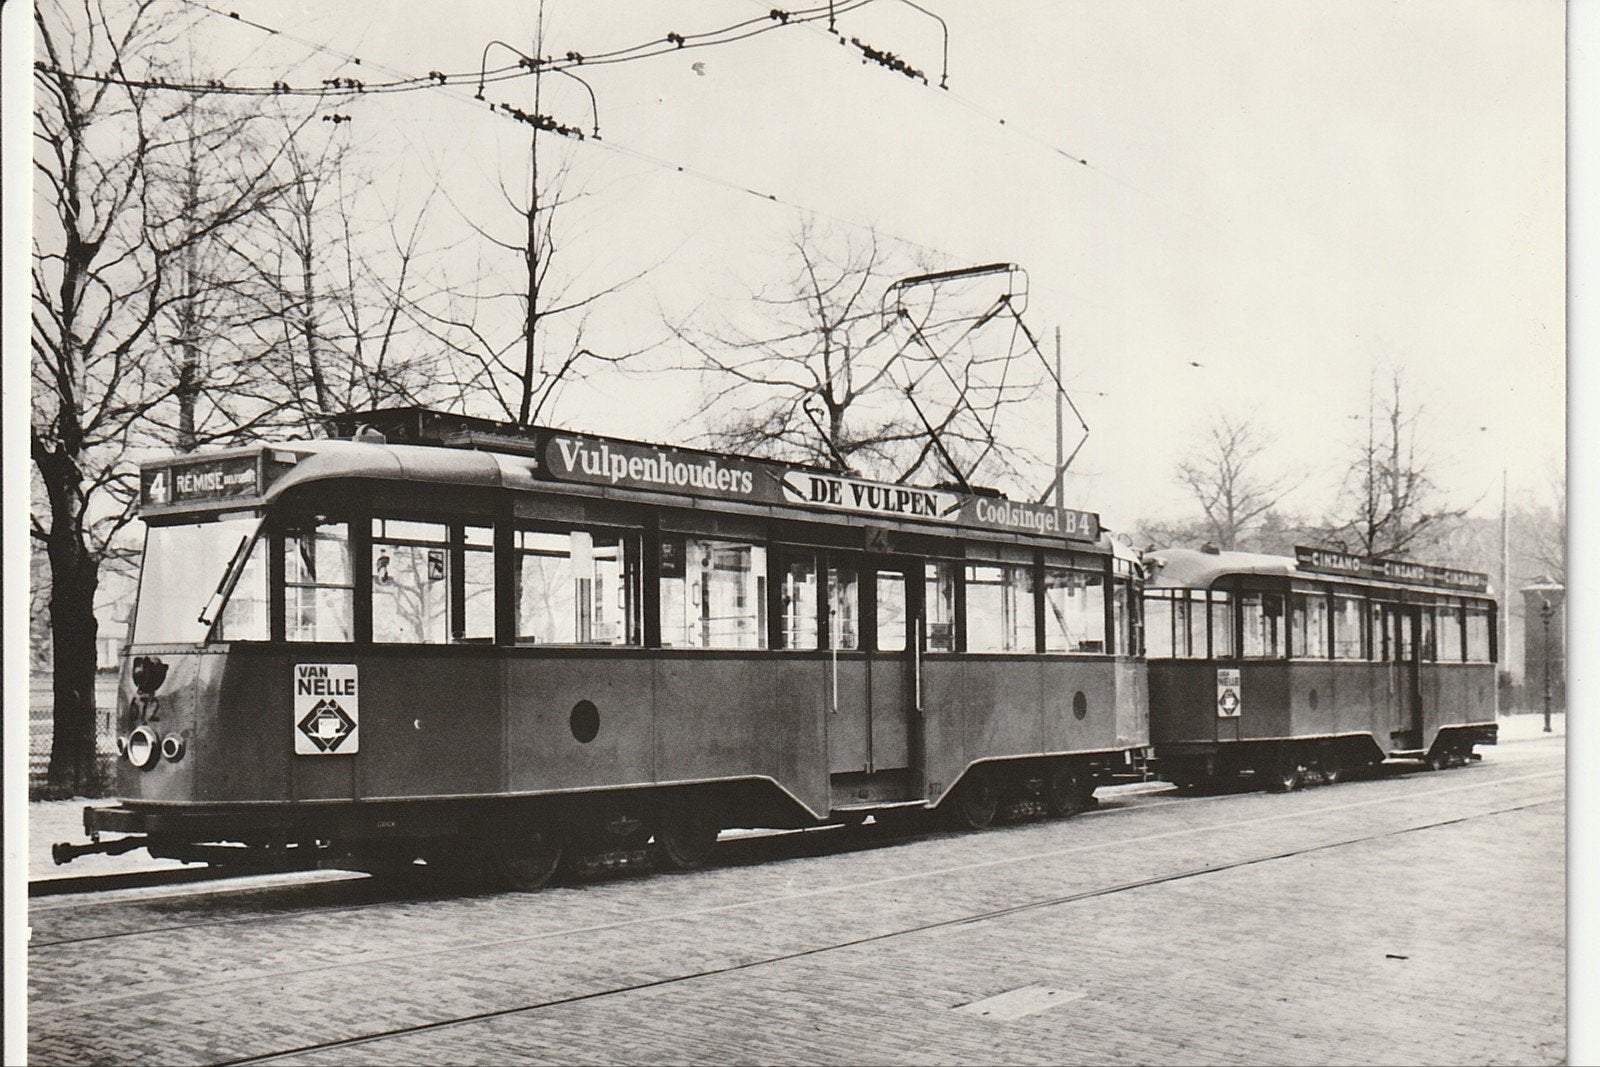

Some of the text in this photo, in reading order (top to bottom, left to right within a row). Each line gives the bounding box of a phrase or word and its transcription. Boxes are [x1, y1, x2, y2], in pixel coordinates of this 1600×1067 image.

[555, 437, 753, 494] Vulpenhouders
[149, 472, 166, 503] 4
[808, 477, 938, 516] DE VULPEN
[976, 498, 1060, 532] Coolsingel
[1312, 552, 1361, 571] CINZANO
[1384, 563, 1425, 579] CINZANO
[299, 666, 328, 678] VAN
[298, 679, 355, 696] NELLE
